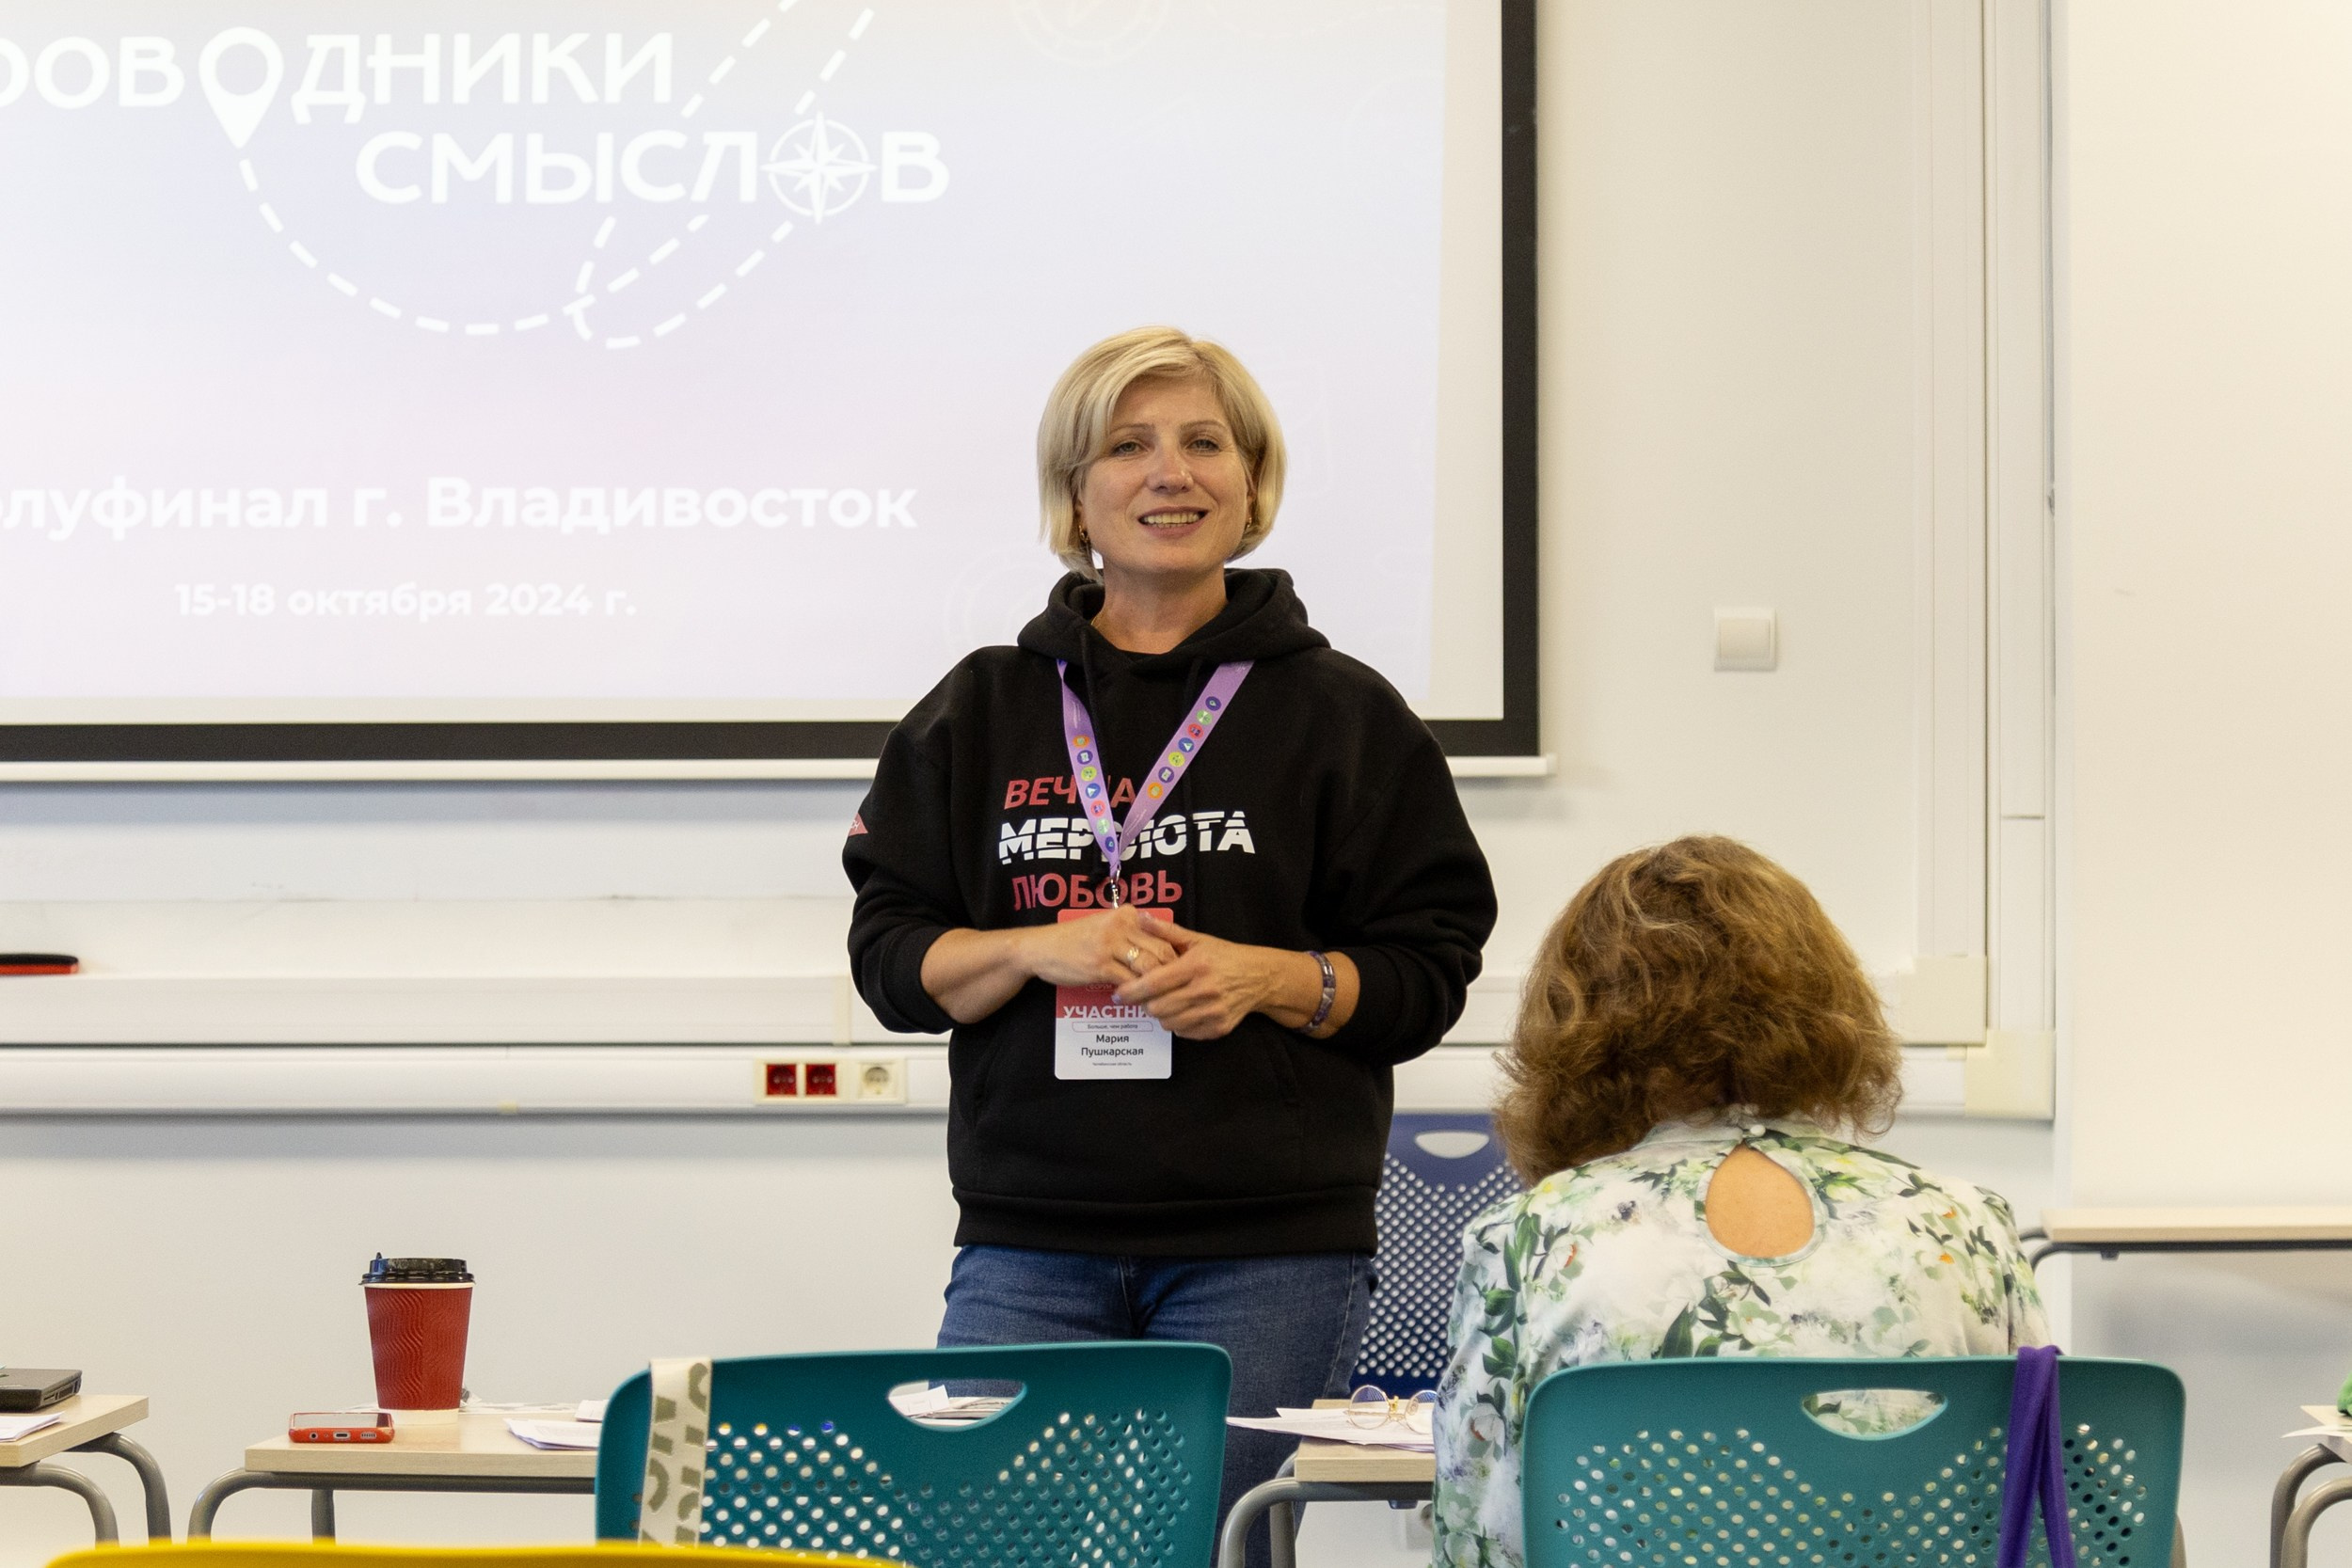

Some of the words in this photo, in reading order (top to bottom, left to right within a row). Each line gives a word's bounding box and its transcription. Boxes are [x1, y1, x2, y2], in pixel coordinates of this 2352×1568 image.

[0, 475, 328, 542] луфинал
[353, 487, 404, 529] г.
[426, 476, 918, 535] Владивосток
[175, 583, 276, 616] 15-18
[287, 581, 472, 623] октября
[485, 583, 593, 616] 2024
[605, 590, 637, 616] г.
[1011, 869, 1183, 911] ЛЮБОВЬ
[1080, 1047, 1145, 1058] Пушкарская
[1095, 1034, 1130, 1045] Мария
